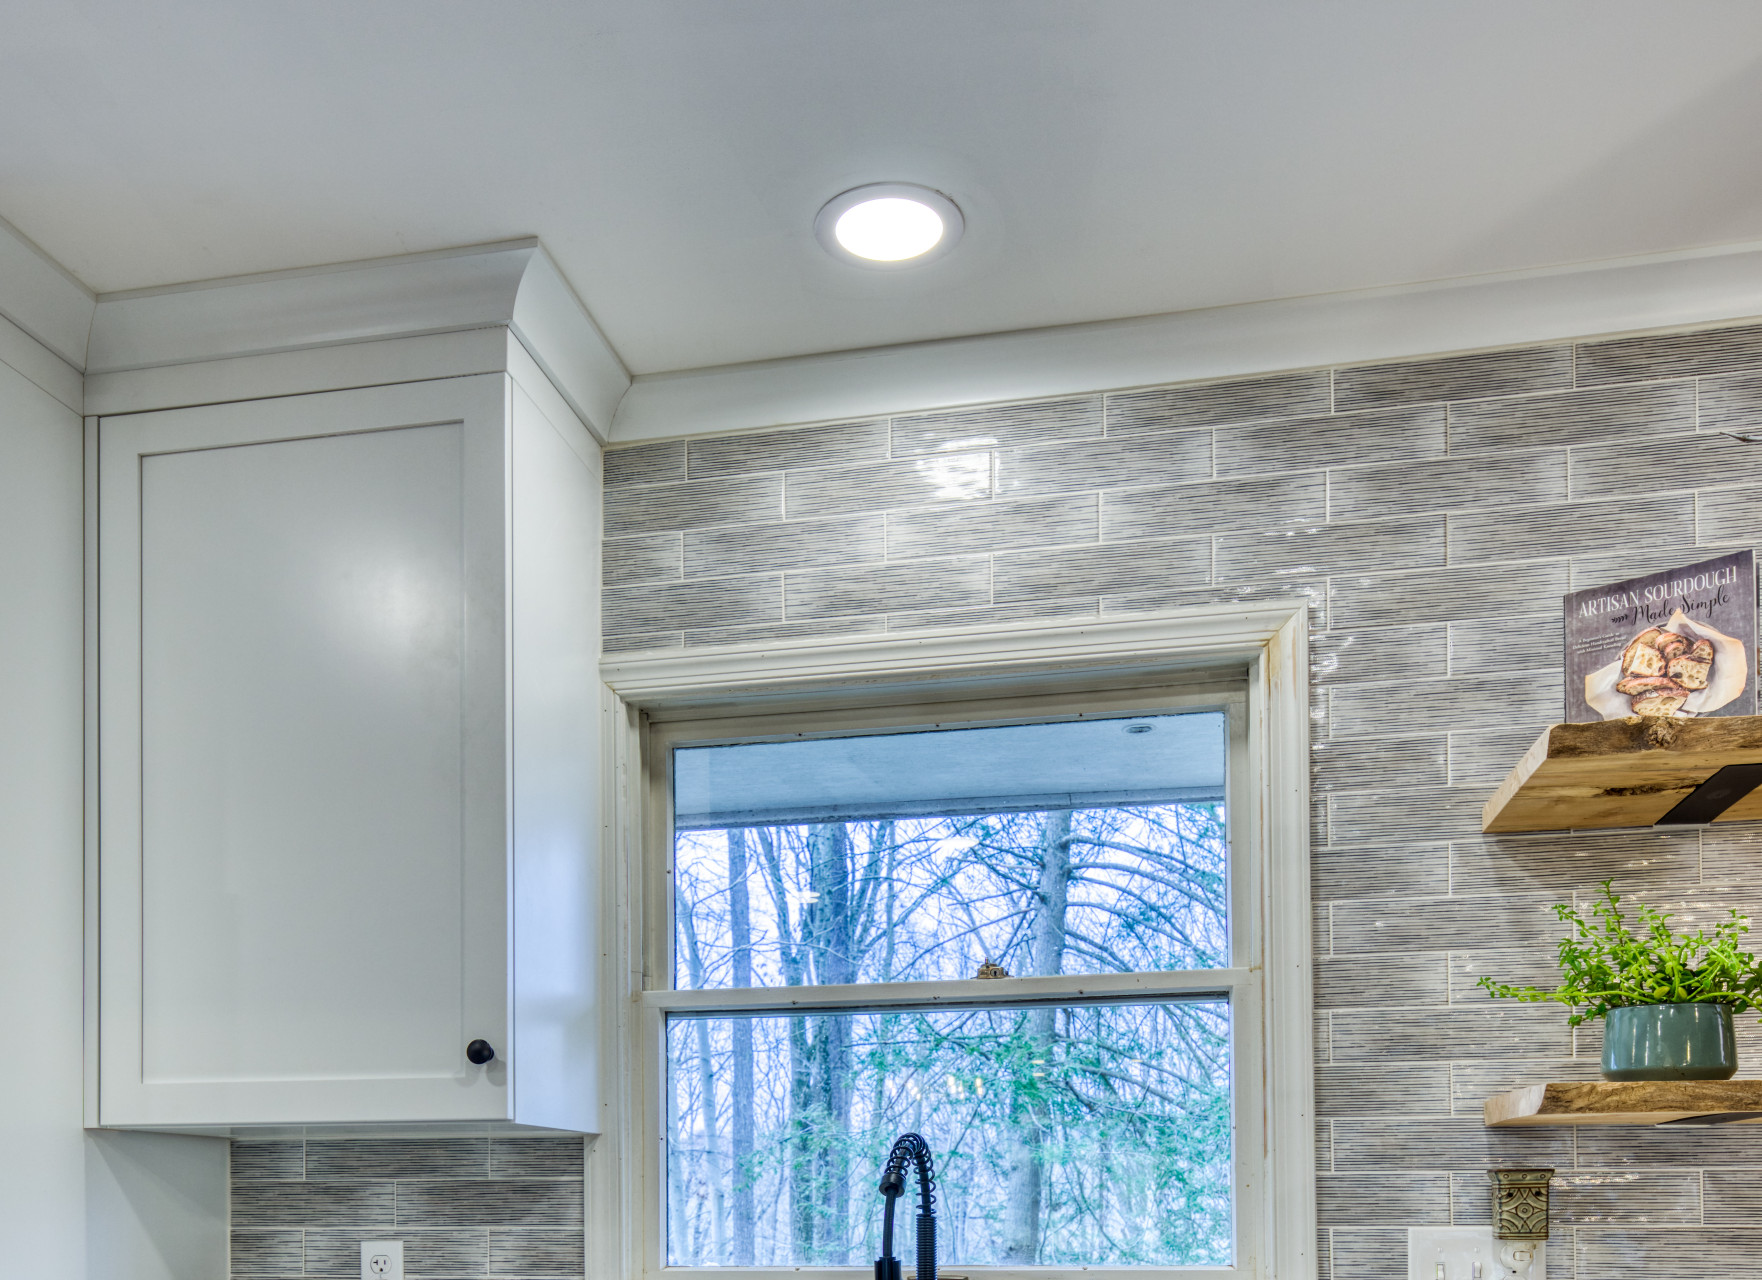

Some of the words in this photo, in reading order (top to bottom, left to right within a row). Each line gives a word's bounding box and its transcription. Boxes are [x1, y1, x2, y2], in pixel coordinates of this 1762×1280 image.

[1578, 589, 1639, 618] ARTISAN
[1644, 565, 1738, 604] SOURDOUGH
[1630, 599, 1675, 626] Made
[1679, 584, 1731, 619] Simple
